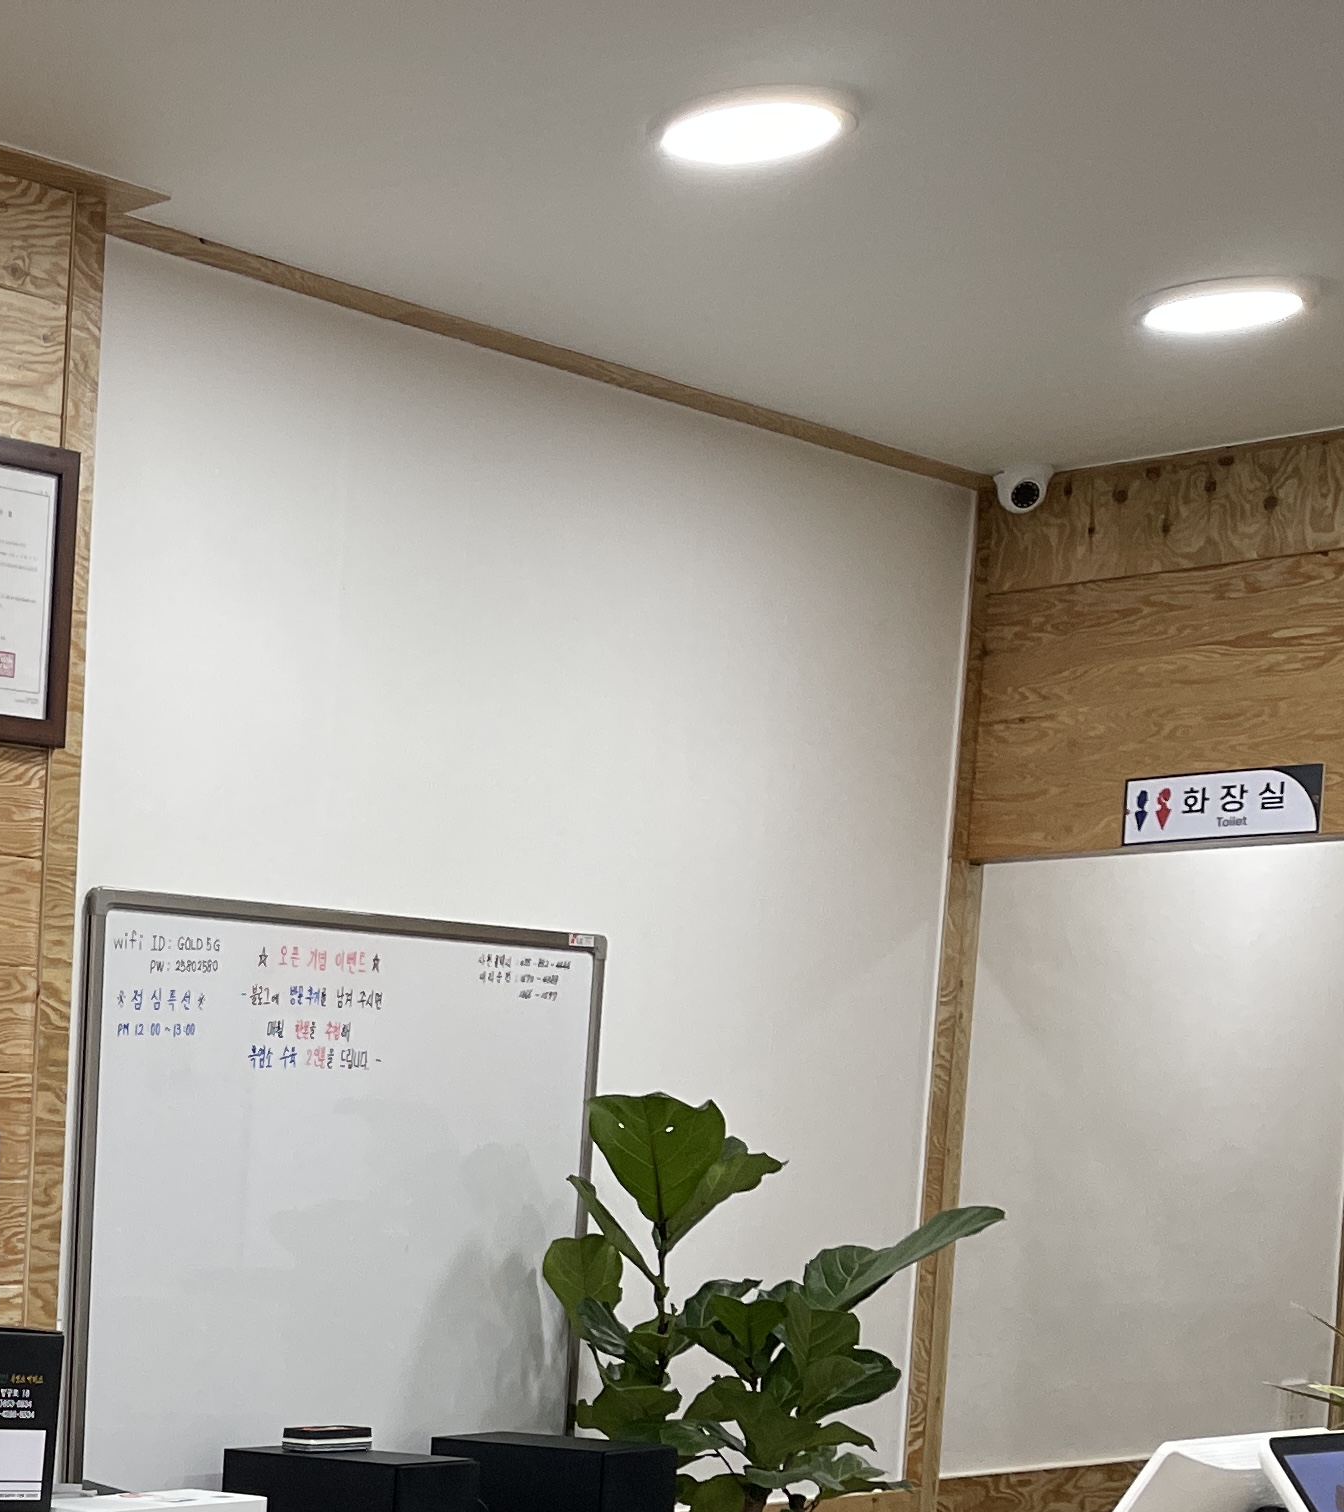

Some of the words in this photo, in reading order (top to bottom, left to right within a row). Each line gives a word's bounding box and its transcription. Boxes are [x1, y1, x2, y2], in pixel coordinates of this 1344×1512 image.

[1181, 780, 1286, 816] 화장실
[1216, 815, 1248, 828] Toilet
[113, 929, 144, 951] wifi
[279, 945, 300, 968] 오픈
[307, 948, 327, 972] 기념
[335, 950, 367, 975] 이벤트
[337, 986, 354, 1009] 남겨
[357, 989, 383, 1010] 주시면
[117, 1023, 130, 1038] PM
[248, 1045, 274, 1069] 흑염소
[279, 1045, 297, 1069] 수육
